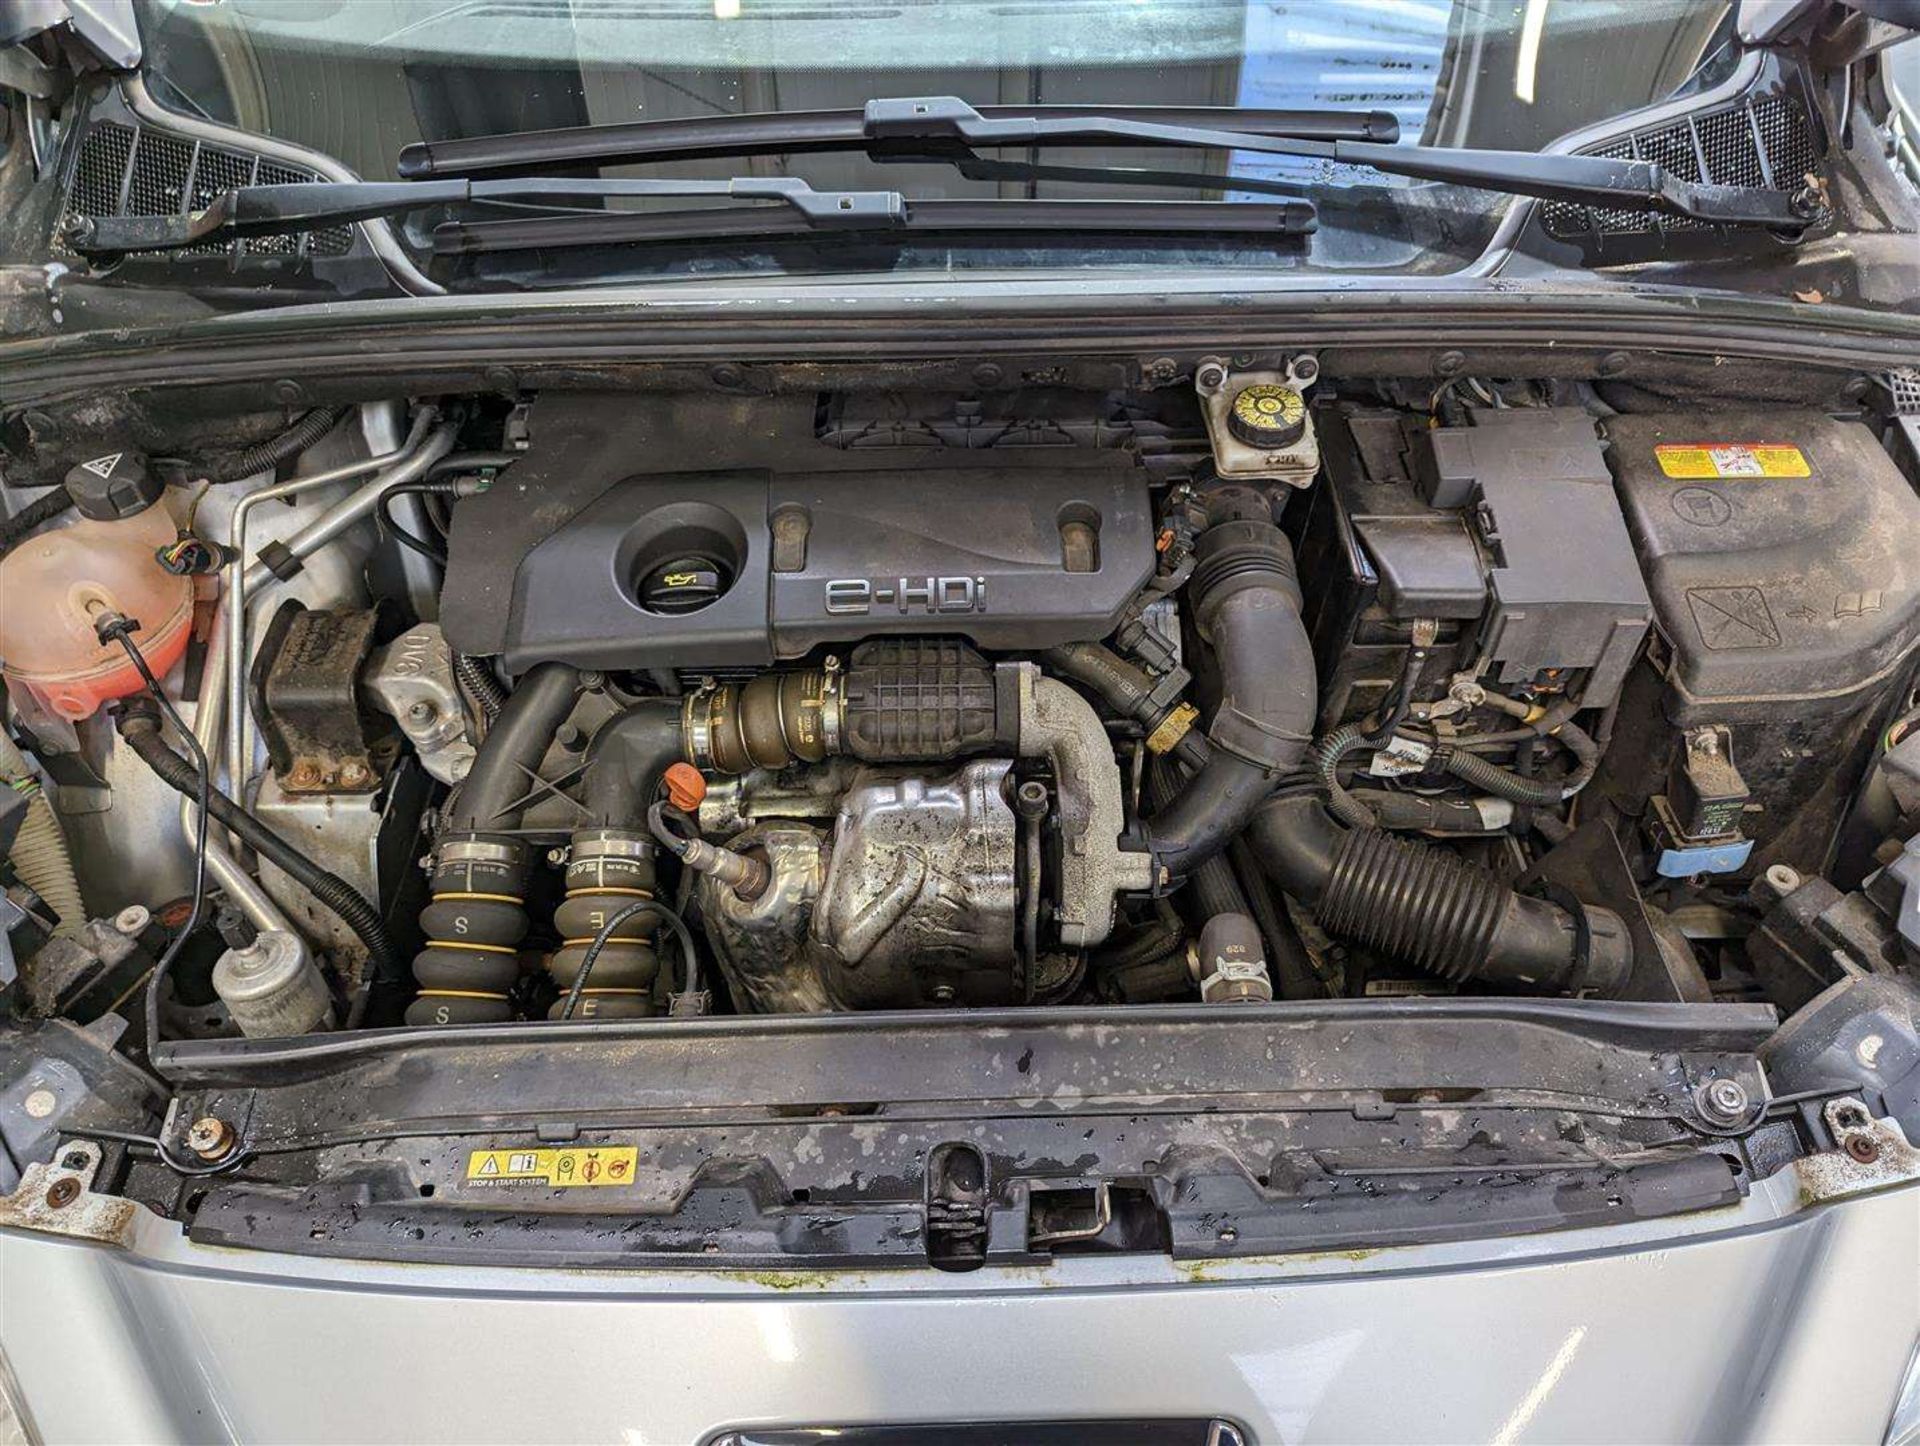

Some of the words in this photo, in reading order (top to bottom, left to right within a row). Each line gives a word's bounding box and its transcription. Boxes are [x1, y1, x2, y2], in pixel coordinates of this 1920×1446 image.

[825, 576, 987, 616] e-HDi
[454, 916, 468, 934] S
[435, 1006, 450, 1024] S
[468, 1179, 488, 1187] STOP
[494, 1178, 518, 1187] START
[518, 1177, 547, 1186] SYSTEM
